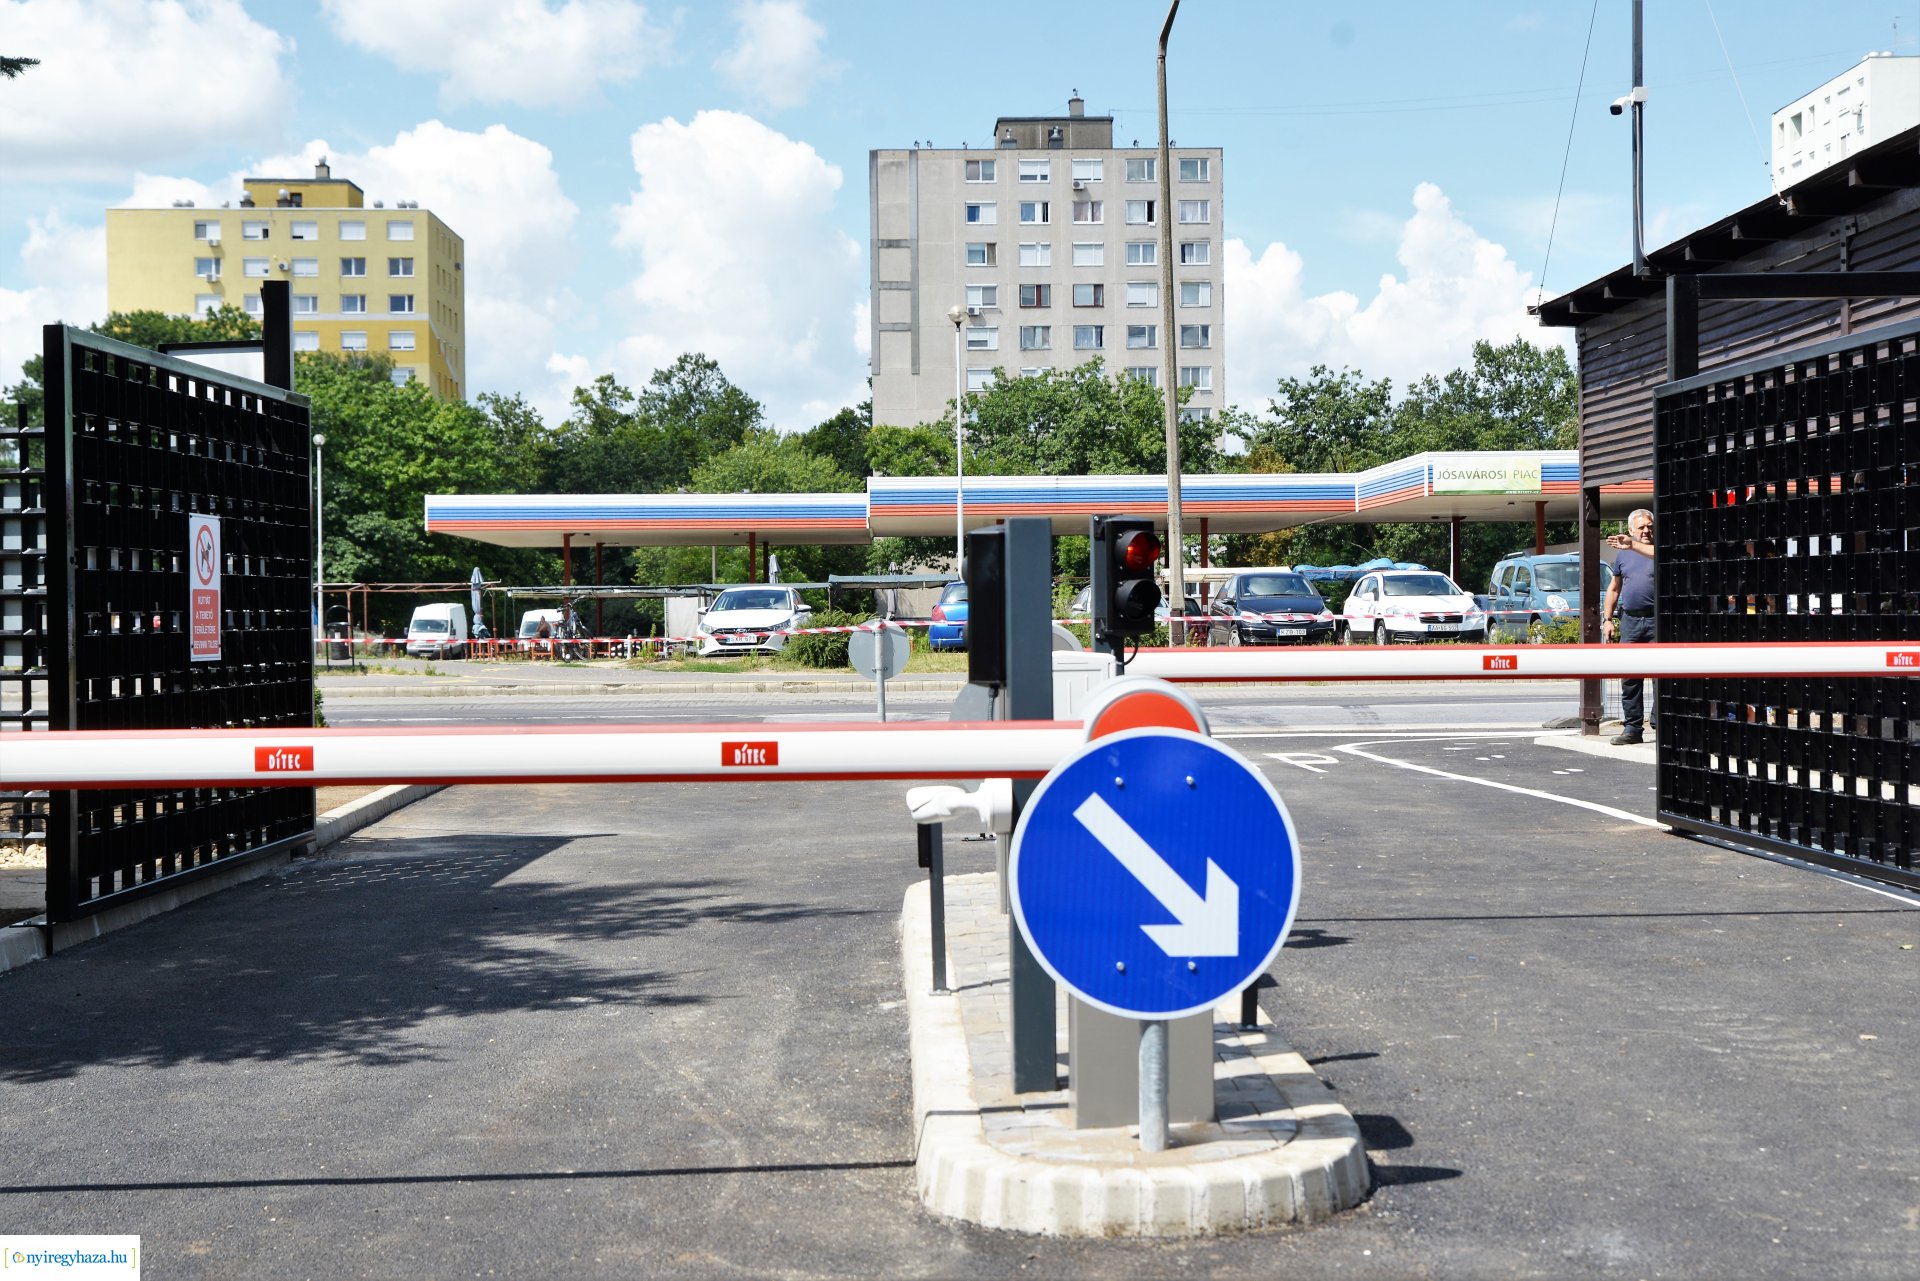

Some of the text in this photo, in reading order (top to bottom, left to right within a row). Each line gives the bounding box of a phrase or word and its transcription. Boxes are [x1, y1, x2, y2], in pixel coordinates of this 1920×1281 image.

[1437, 468, 1538, 480] JÓSAVÁROSI PIAC
[195, 611, 199, 619] A
